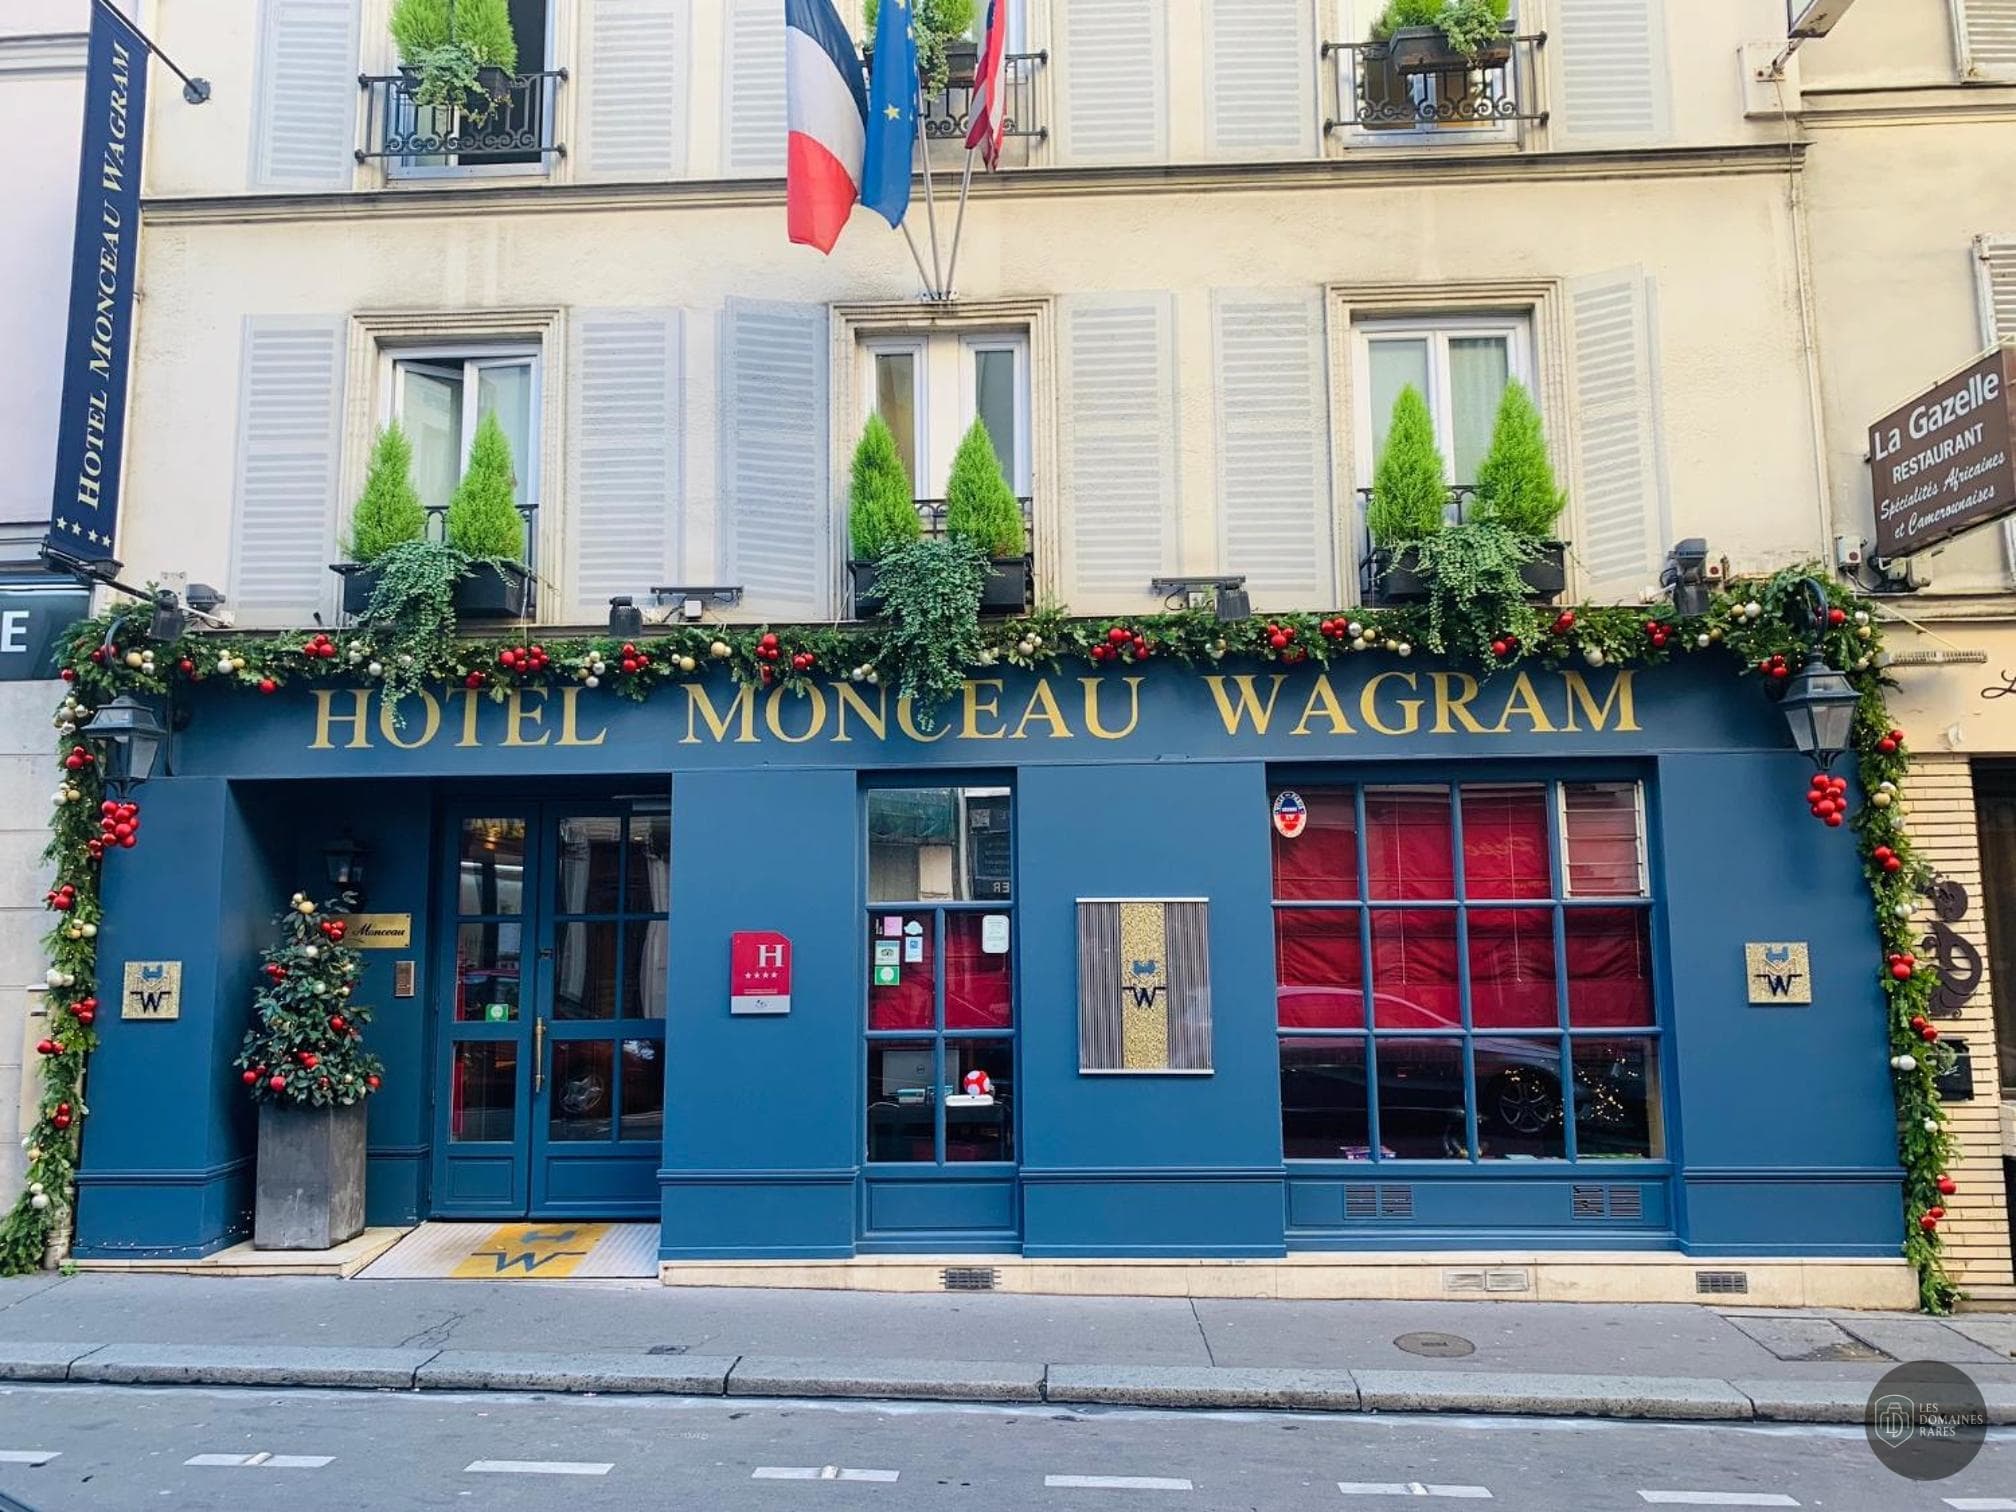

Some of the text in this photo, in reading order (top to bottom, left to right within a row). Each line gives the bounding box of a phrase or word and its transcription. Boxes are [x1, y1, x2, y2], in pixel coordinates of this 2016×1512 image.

[77, 39, 130, 511] HOTEL MONCEAU WAGRAM
[1874, 372, 2000, 461] La Gazelle
[1892, 422, 1984, 485] RESTAURANT
[1942, 450, 2006, 492] Africaines
[1894, 484, 1995, 539] et Camerounaises
[1, 610, 30, 652] E
[307, 669, 1643, 749] HOTEL MONCEAU WAGRAM
[352, 922, 405, 936] Monceau
[756, 944, 785, 968] H
